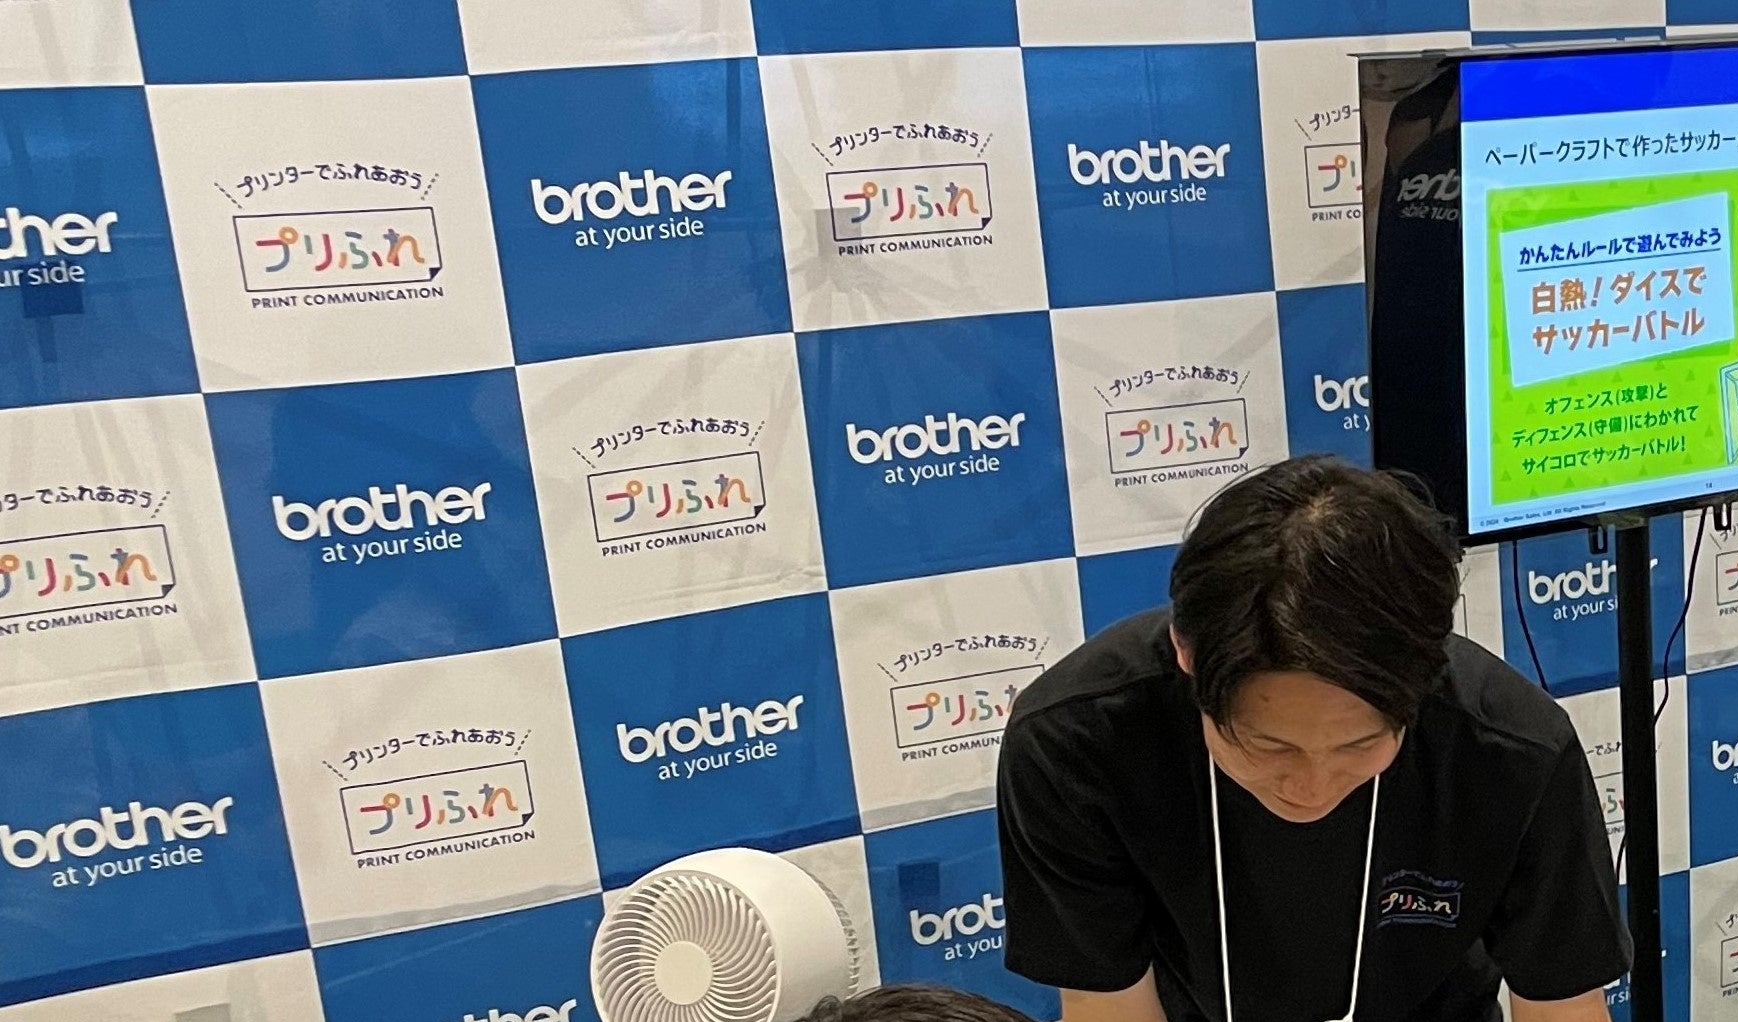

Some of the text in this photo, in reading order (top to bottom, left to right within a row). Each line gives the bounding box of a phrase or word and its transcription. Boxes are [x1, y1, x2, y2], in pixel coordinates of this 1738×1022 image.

[830, 124, 980, 157] プリンターでふれあおう
[237, 163, 421, 197] プリンターでふれあおう
[1068, 140, 1230, 188] brother
[531, 170, 731, 224] brother
[844, 182, 979, 223] プリふれ
[1103, 183, 1206, 210] at your side
[576, 217, 703, 249] at your side
[1312, 211, 1342, 221] PRINT
[256, 227, 425, 272] プリふれ
[839, 235, 992, 256] PRINT COMMUNICATION
[1519, 228, 1722, 265] かんたんルールで遊んでみよう
[28, 260, 85, 285] side
[252, 287, 443, 308] PRINT COMMUNICATION
[1532, 311, 1704, 355] サッカーバトル
[1109, 366, 1238, 397] プリンターでふれあおう
[591, 418, 749, 458] プリンターでふれあおう
[846, 413, 1025, 465] brother
[1120, 417, 1237, 457] プリふれ
[1344, 414, 1359, 429] at
[885, 454, 999, 485] at your side
[1115, 462, 1248, 487] PRINT COMMUNICATION
[272, 483, 491, 541] brother
[606, 474, 751, 522] プリふれ
[323, 530, 462, 564] at your side
[602, 523, 766, 556] PRINT COMMUNICATION
[26, 603, 177, 631] COMMUNICATION
[1554, 601, 1604, 620] at your
[894, 635, 1036, 672] プリンターでふれあおう
[617, 695, 803, 763] brother
[343, 729, 516, 770] プリンターでふれあおう
[659, 740, 777, 779] at your side
[902, 748, 937, 761] PRINT
[360, 783, 518, 835] プリふれ
[0, 797, 232, 868] brother
[358, 829, 535, 868] PRINT COMMUNICATION
[52, 845, 202, 887] at your side
[945, 944, 962, 960] at
